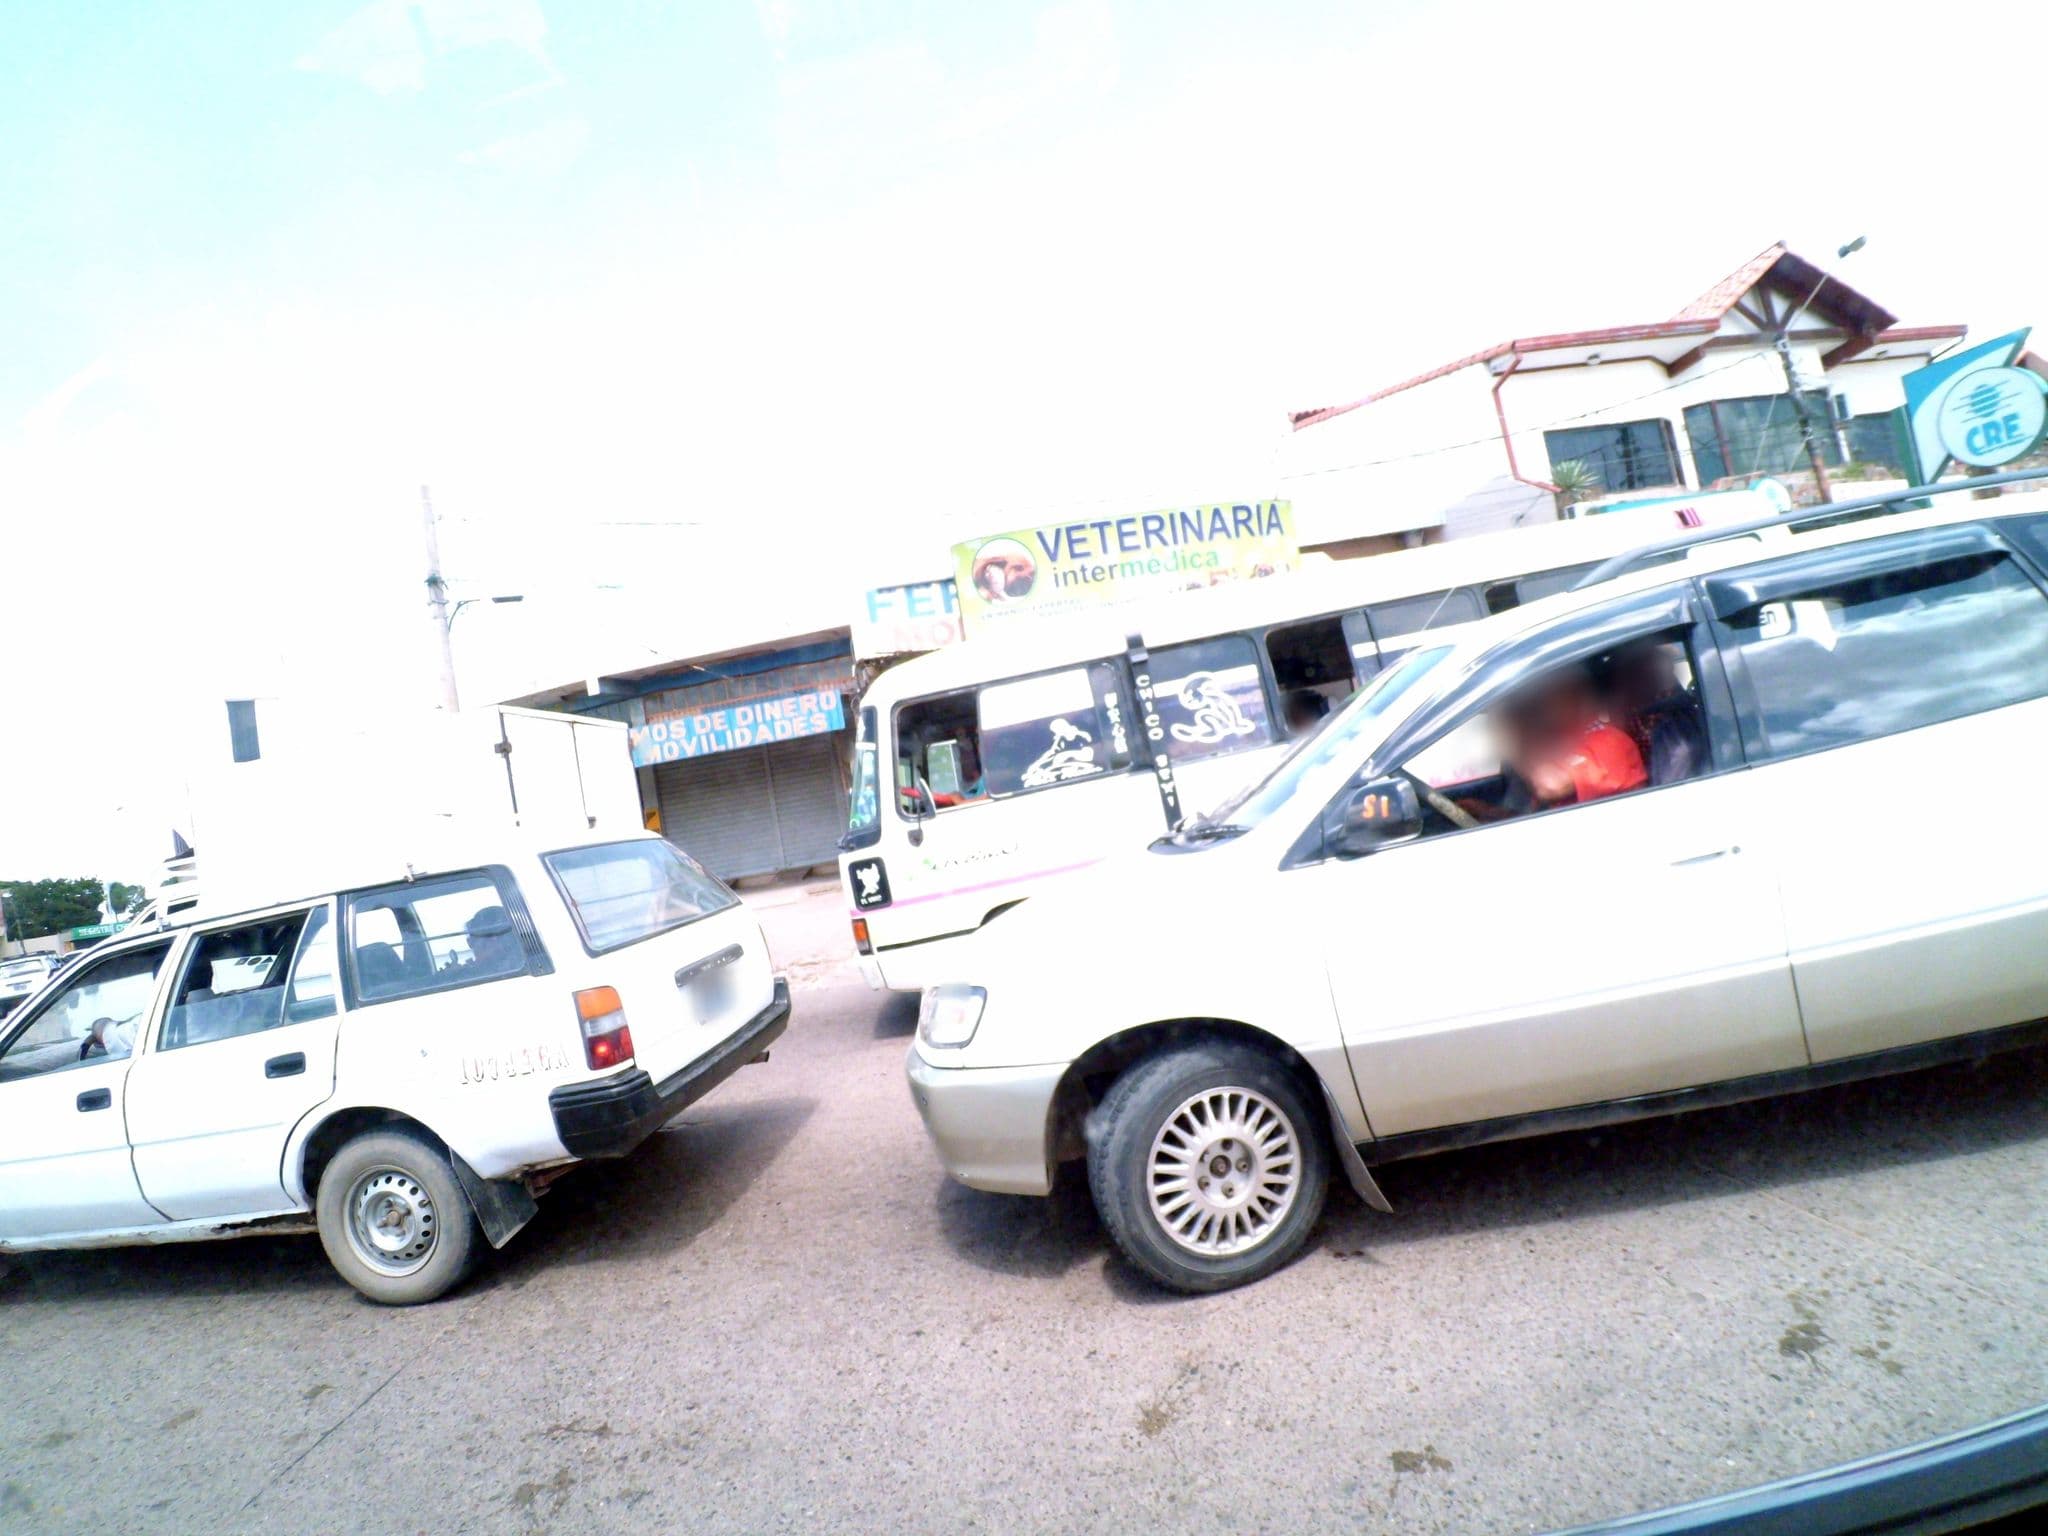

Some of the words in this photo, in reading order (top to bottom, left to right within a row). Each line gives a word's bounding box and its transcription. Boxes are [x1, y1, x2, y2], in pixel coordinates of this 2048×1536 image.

[1966, 411, 2020, 456] CRE
[1036, 502, 1285, 563] VETERINARIA
[1052, 549, 1220, 589] intermedica
[694, 710, 729, 735] DE
[735, 689, 837, 727] DINERO
[1135, 674, 1164, 741] CHICO
